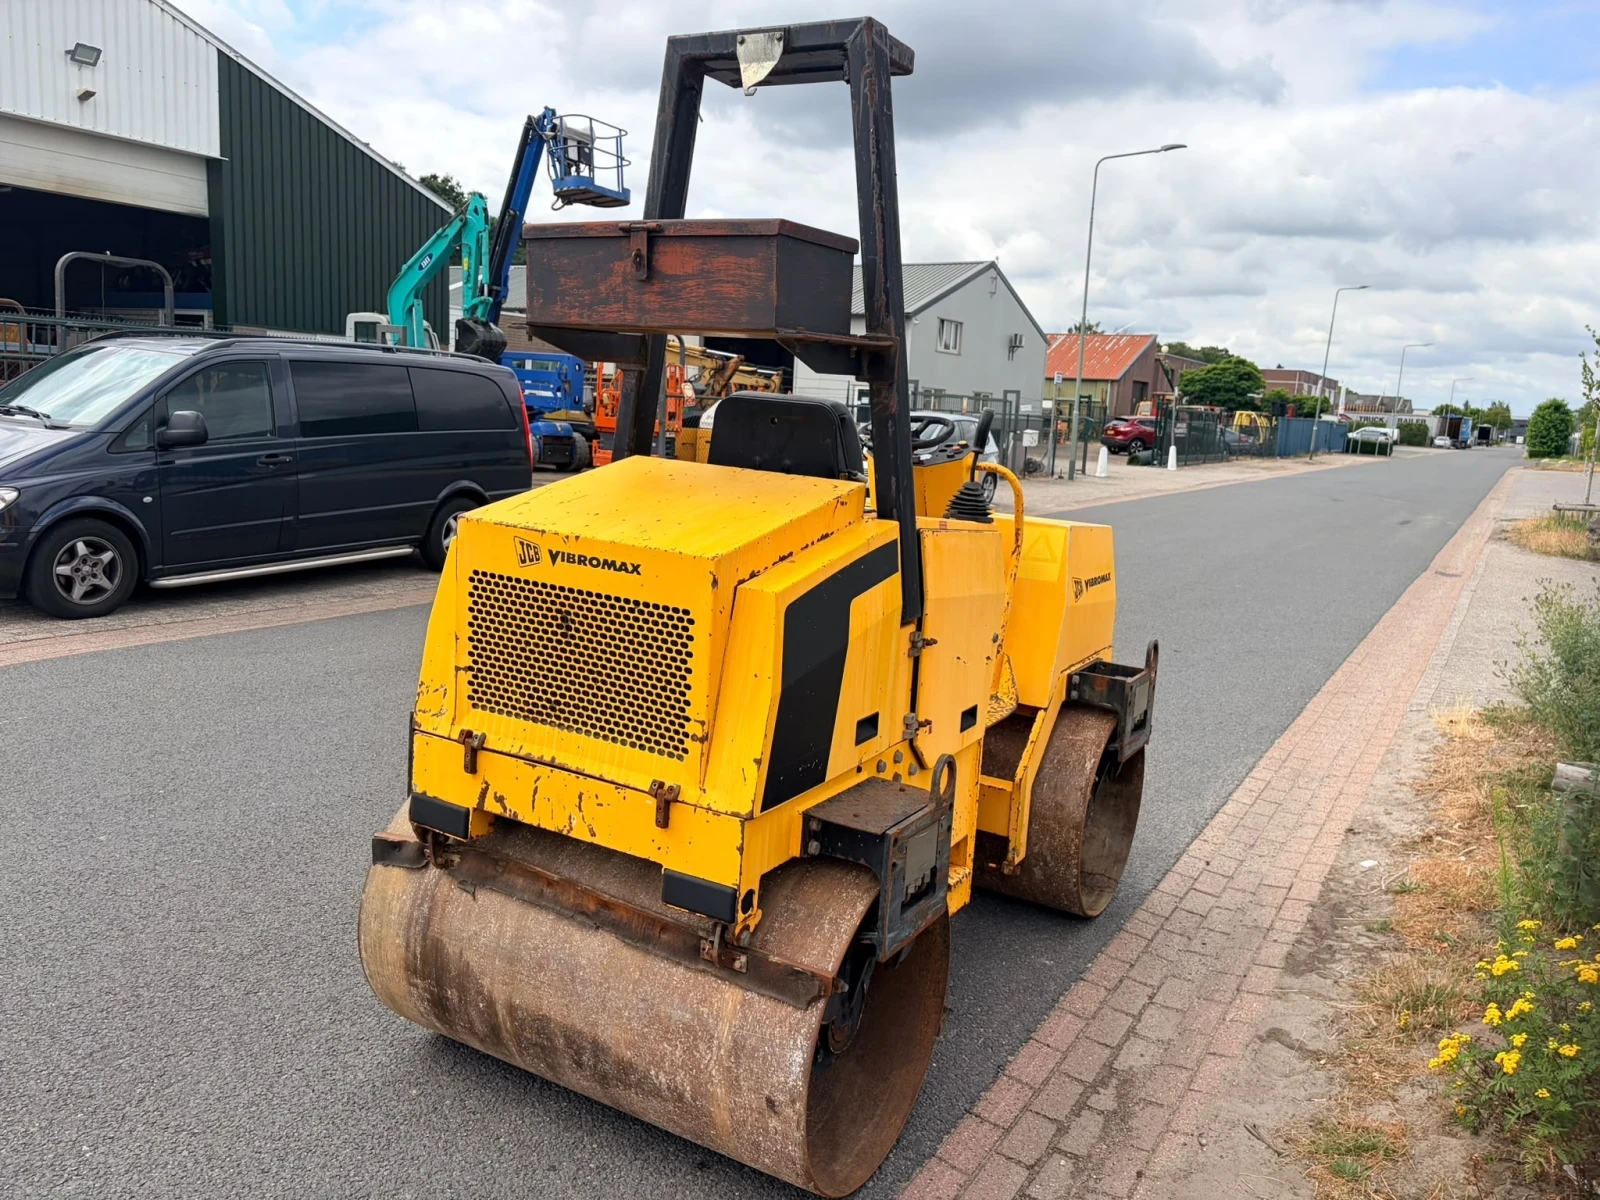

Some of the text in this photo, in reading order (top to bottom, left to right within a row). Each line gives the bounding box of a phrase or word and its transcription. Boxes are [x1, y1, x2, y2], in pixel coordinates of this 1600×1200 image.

[519, 540, 642, 576] JCB VIBROMAX
[1084, 571, 1112, 593] VIBROMAX
